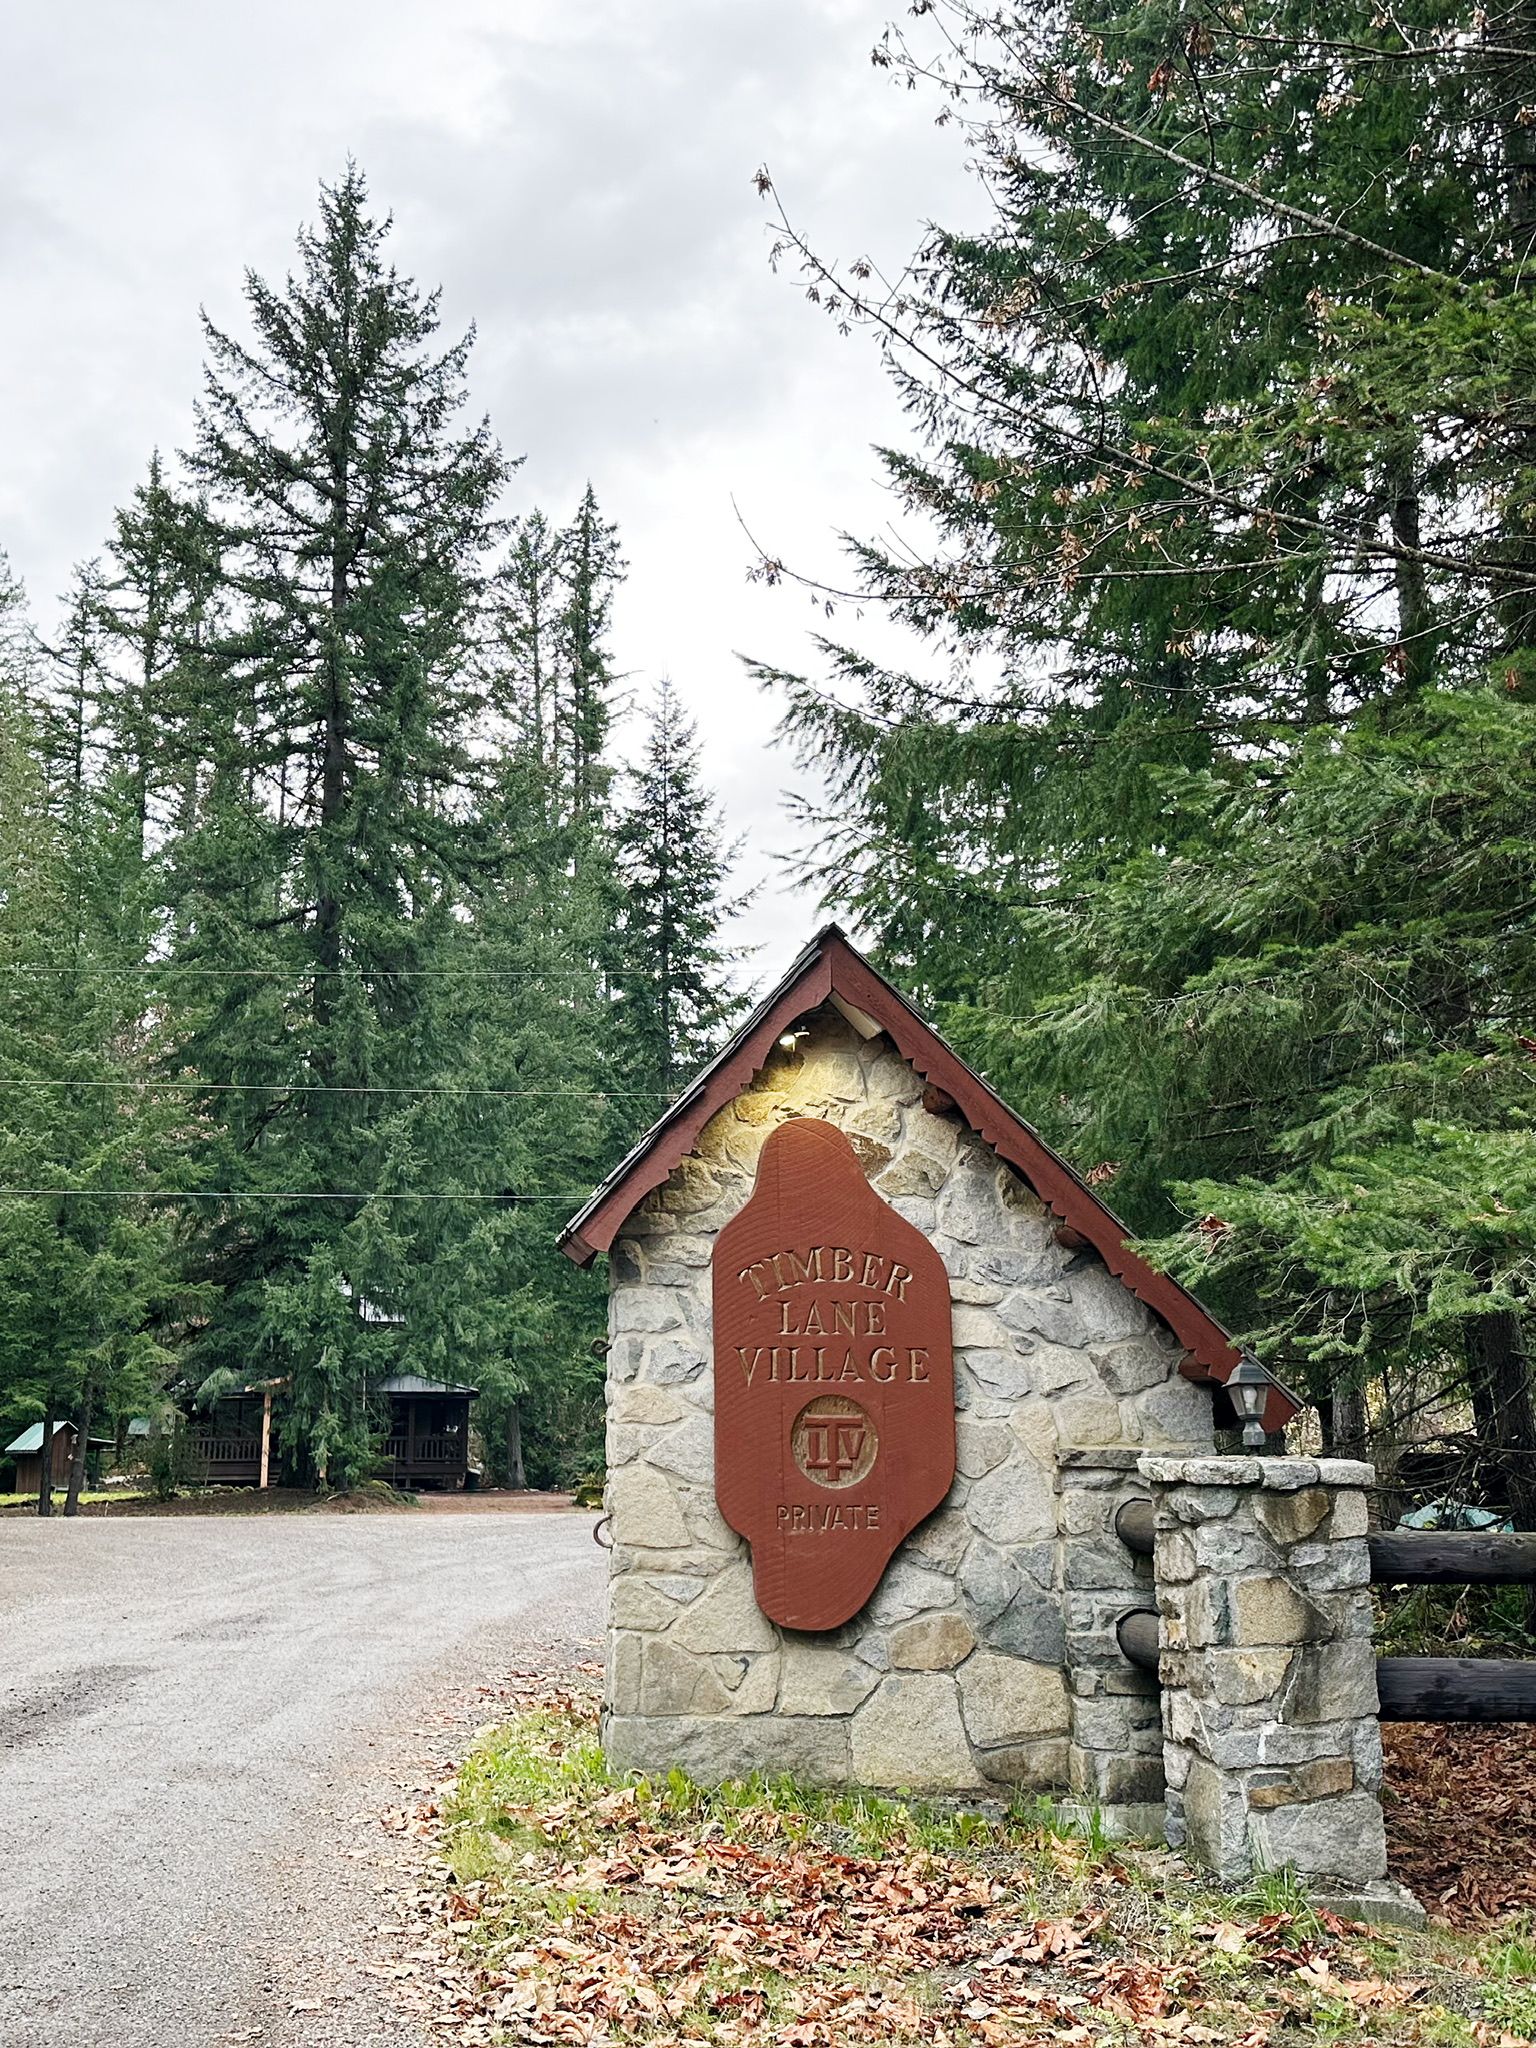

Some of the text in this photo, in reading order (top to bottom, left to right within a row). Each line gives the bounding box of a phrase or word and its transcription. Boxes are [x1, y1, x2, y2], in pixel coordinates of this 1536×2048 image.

[737, 1246, 913, 1304] TIMBER
[777, 1300, 887, 1336] LANE
[734, 1346, 930, 1387] VILLAGE
[776, 1504, 880, 1530] PRIVATE
